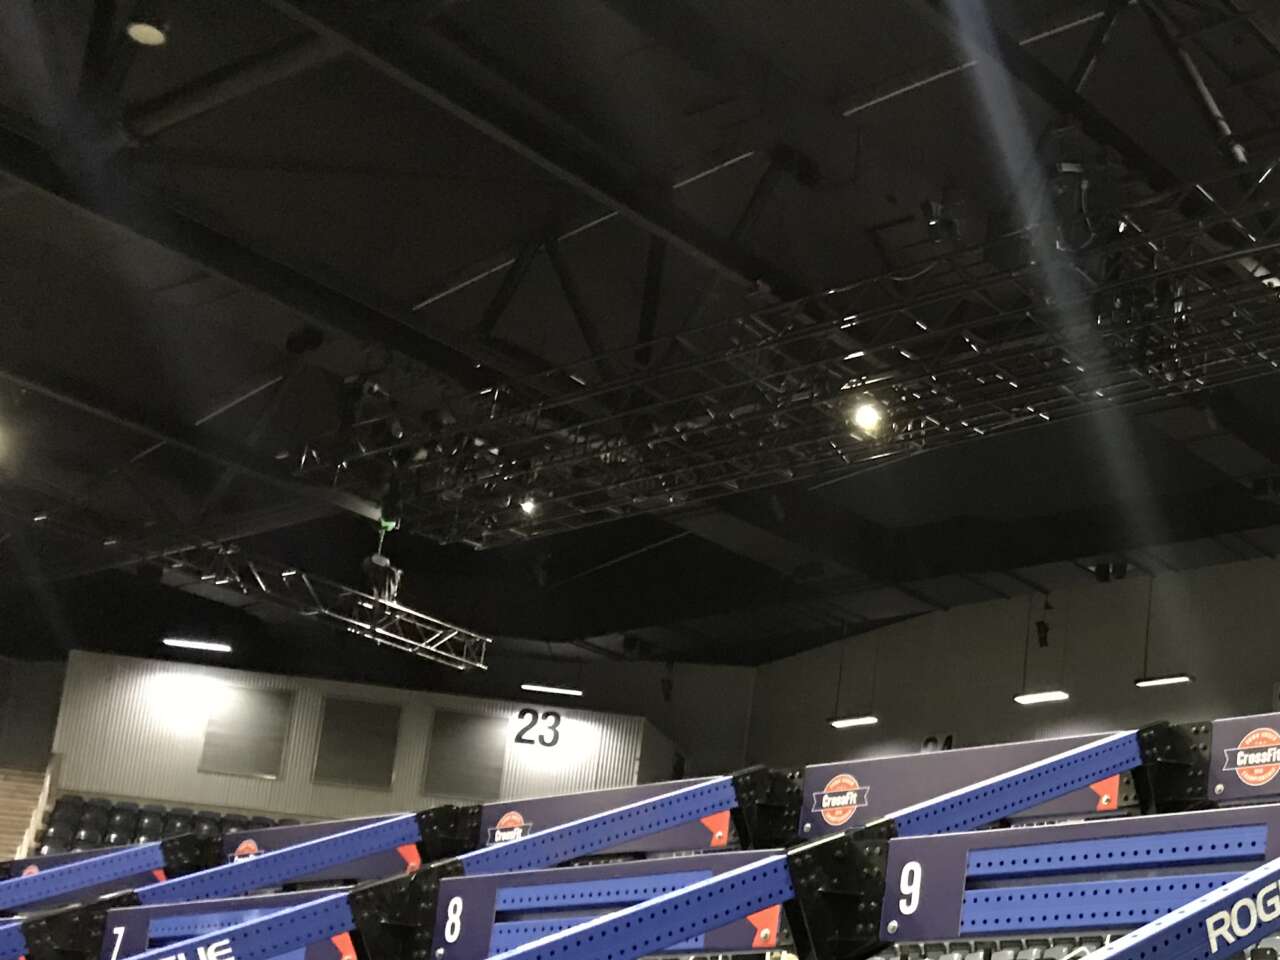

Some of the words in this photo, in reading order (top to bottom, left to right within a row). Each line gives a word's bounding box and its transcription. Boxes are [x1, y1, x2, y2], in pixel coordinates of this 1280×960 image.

[514, 708, 561, 747] 23
[822, 791, 858, 808] CrossFit
[899, 861, 922, 915] 9
[443, 897, 464, 944] 8
